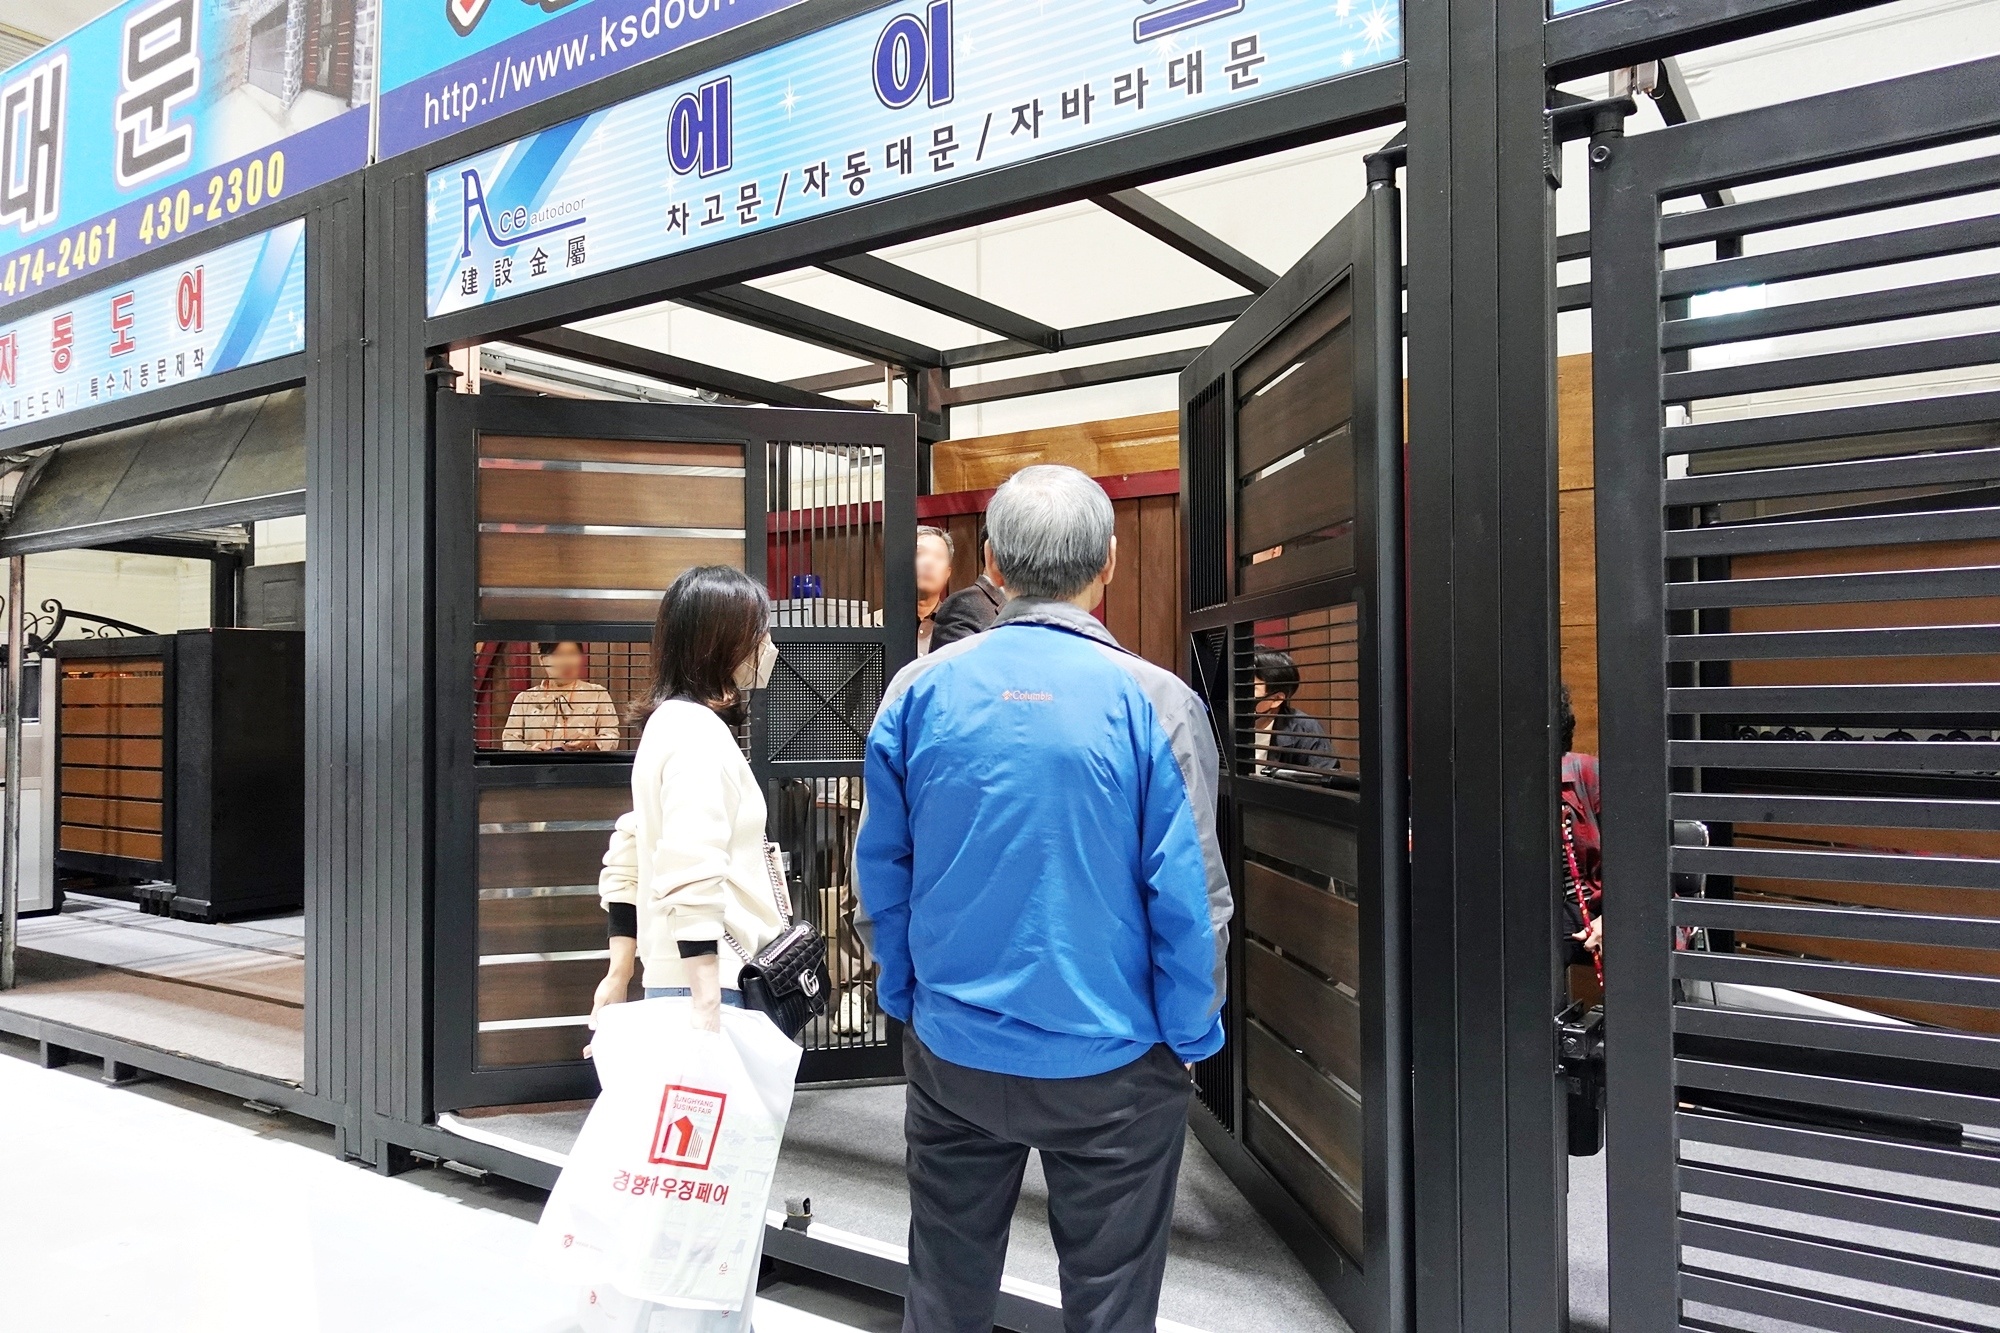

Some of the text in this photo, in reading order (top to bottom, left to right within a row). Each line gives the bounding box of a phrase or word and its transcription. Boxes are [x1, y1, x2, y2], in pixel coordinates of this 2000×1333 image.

[0, 150, 285, 297] 474-2461 430-2300
[530, 198, 586, 225] autodoor
[460, 235, 587, 298] 建設金屬
[1012, 690, 1053, 701] Columbia
